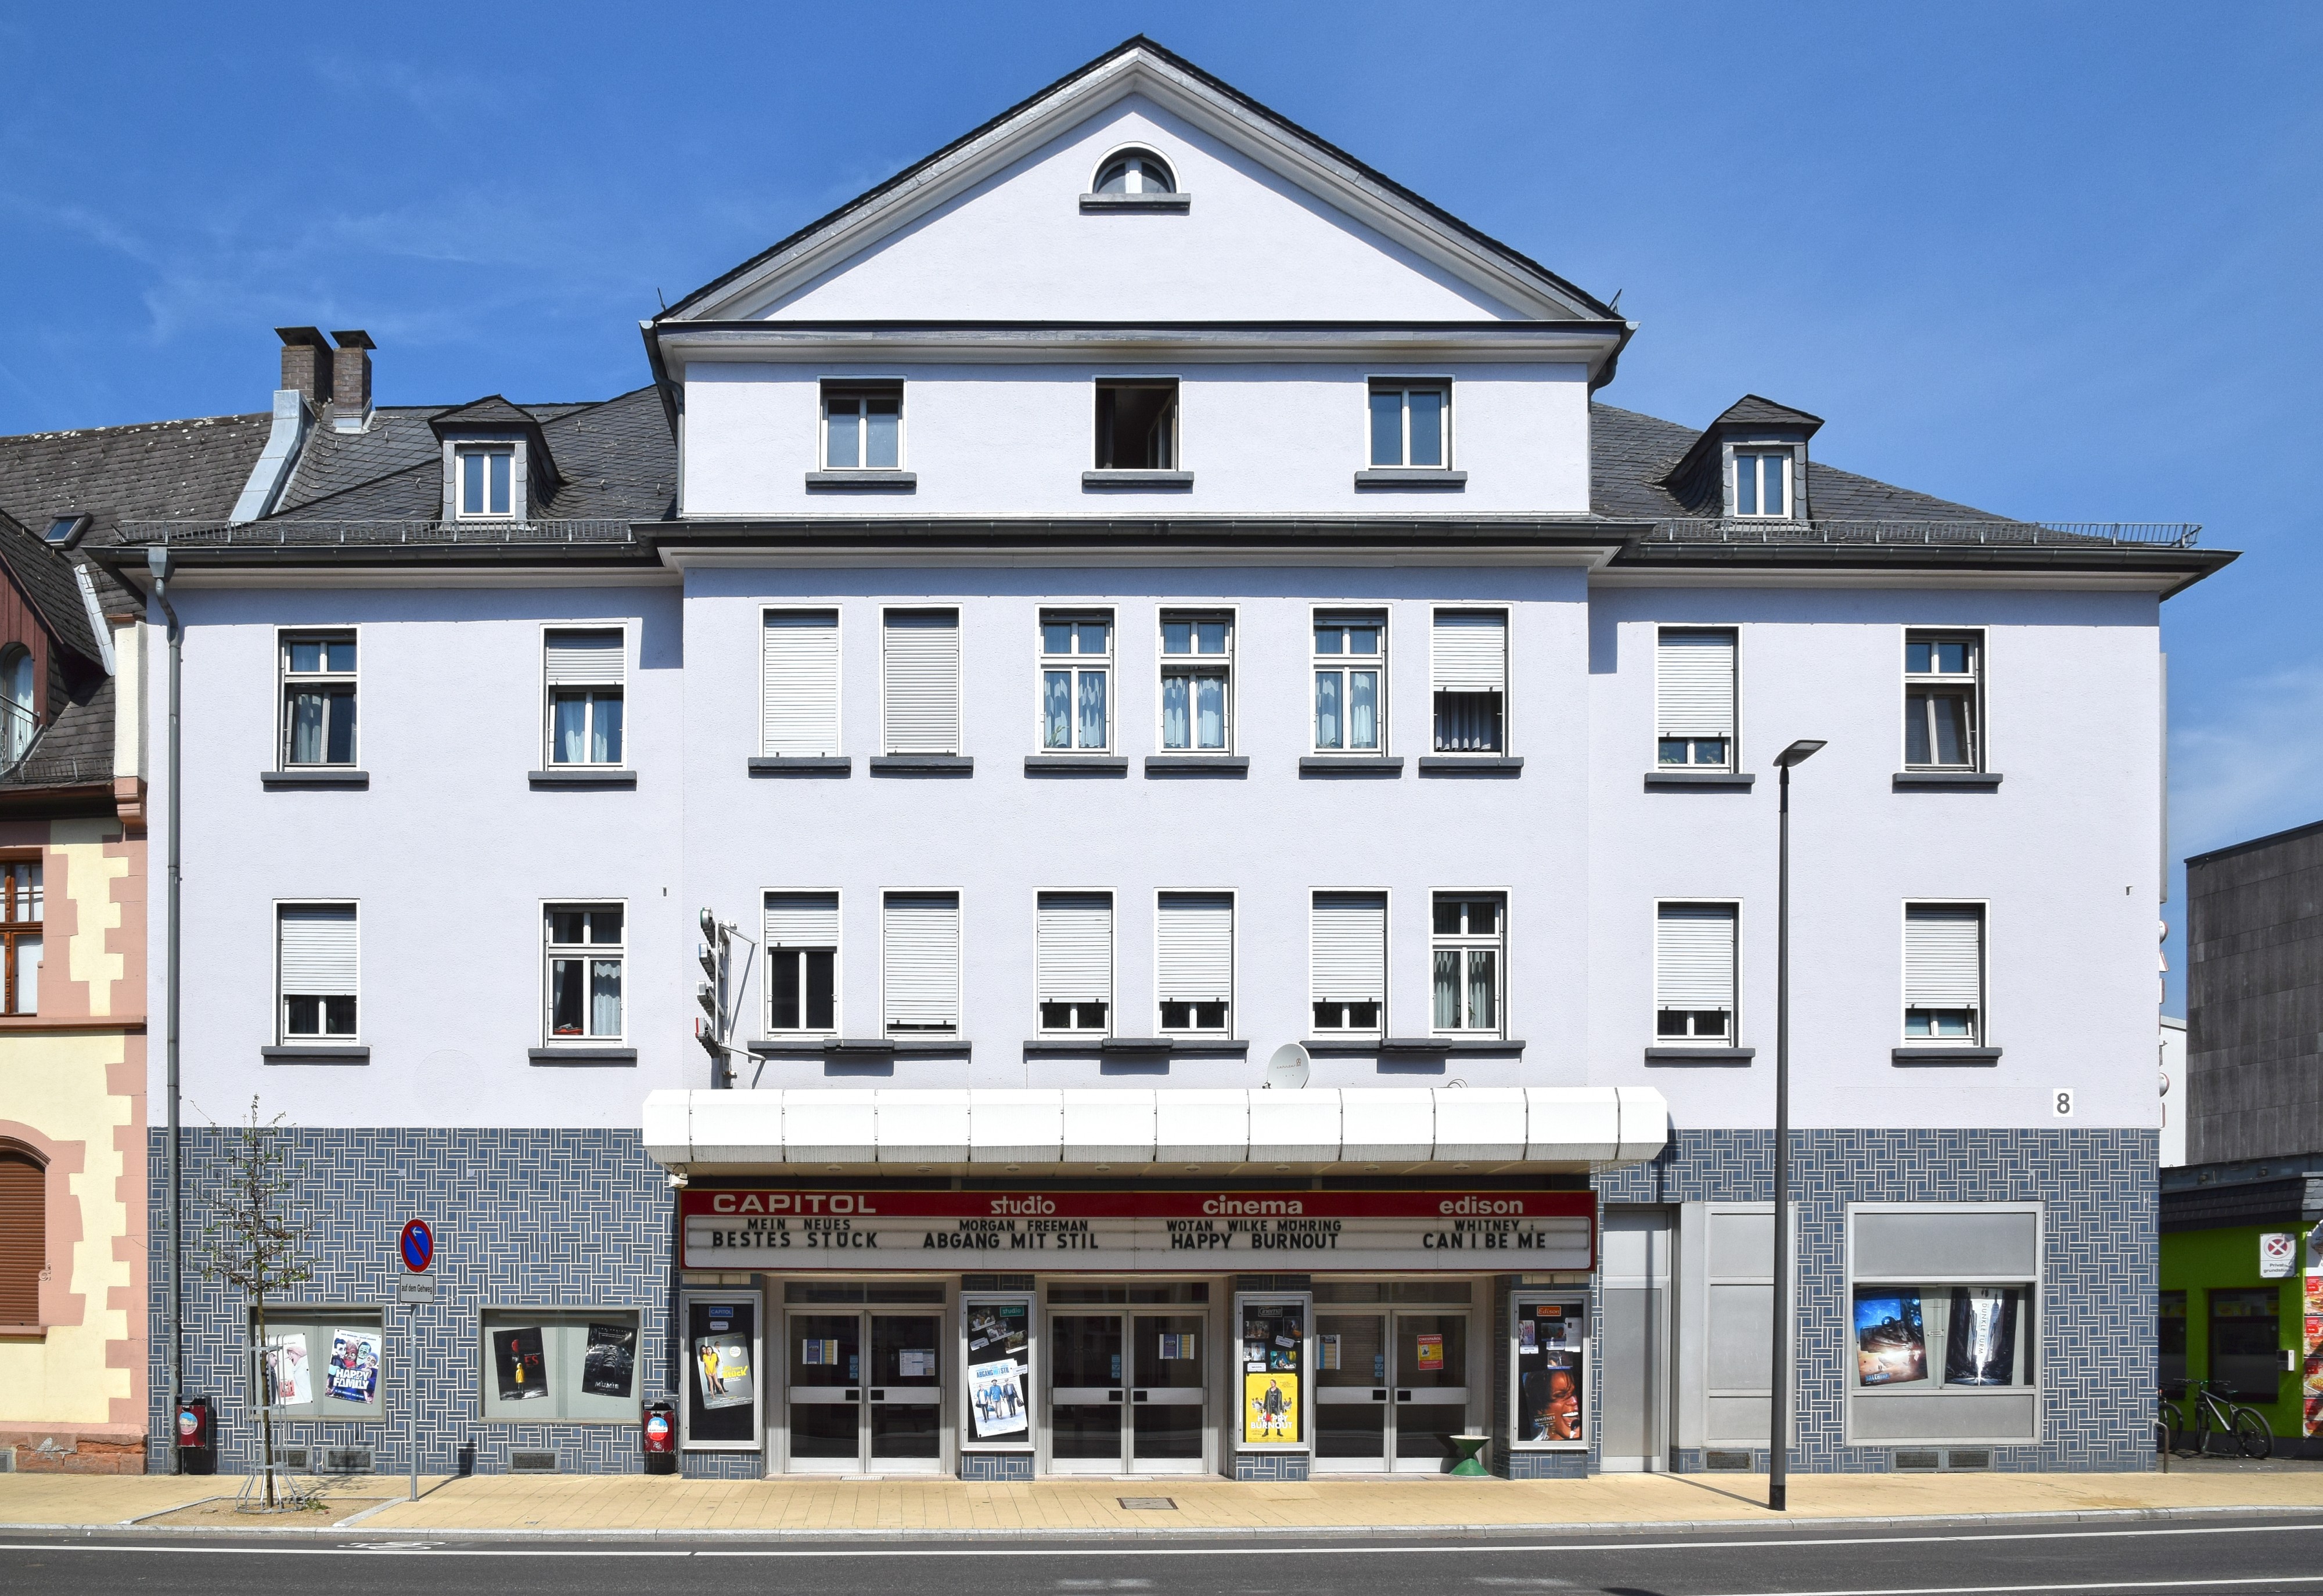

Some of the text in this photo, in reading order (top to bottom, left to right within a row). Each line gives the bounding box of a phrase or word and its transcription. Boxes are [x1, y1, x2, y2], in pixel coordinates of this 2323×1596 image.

[2057, 1093, 2070, 1114] 8
[713, 1194, 876, 1213] CAPITOL
[991, 1195, 1056, 1214] studio
[1203, 1195, 1303, 1214] cinema
[1439, 1196, 1523, 1214] edison
[747, 1219, 851, 1230] MEIN NEUES
[959, 1220, 1088, 1231] MORGAN FREEMAN
[1167, 1220, 1342, 1231] WOTAN WILKE MÖHRING
[1455, 1220, 1520, 1231] WHITNEY
[713, 1231, 878, 1248] BESTES STÜCK
[923, 1233, 1099, 1249] ABGANG MIT STIL
[1171, 1233, 1338, 1249] HAPPY BURNOUT
[1423, 1233, 1545, 1248] CAN I BE ME
[408, 1284, 417, 1292] dem
[417, 1284, 433, 1295] Gehweg
[1260, 1307, 1281, 1316] Cinema
[524, 1355, 540, 1366] ES
[336, 1368, 369, 1381] HAPPY
[976, 1370, 994, 1378] ABGANG
[333, 1377, 369, 1389] FAMILY
[595, 1381, 620, 1389] MUMIE
[1257, 1413, 1289, 1422] HAPPY
